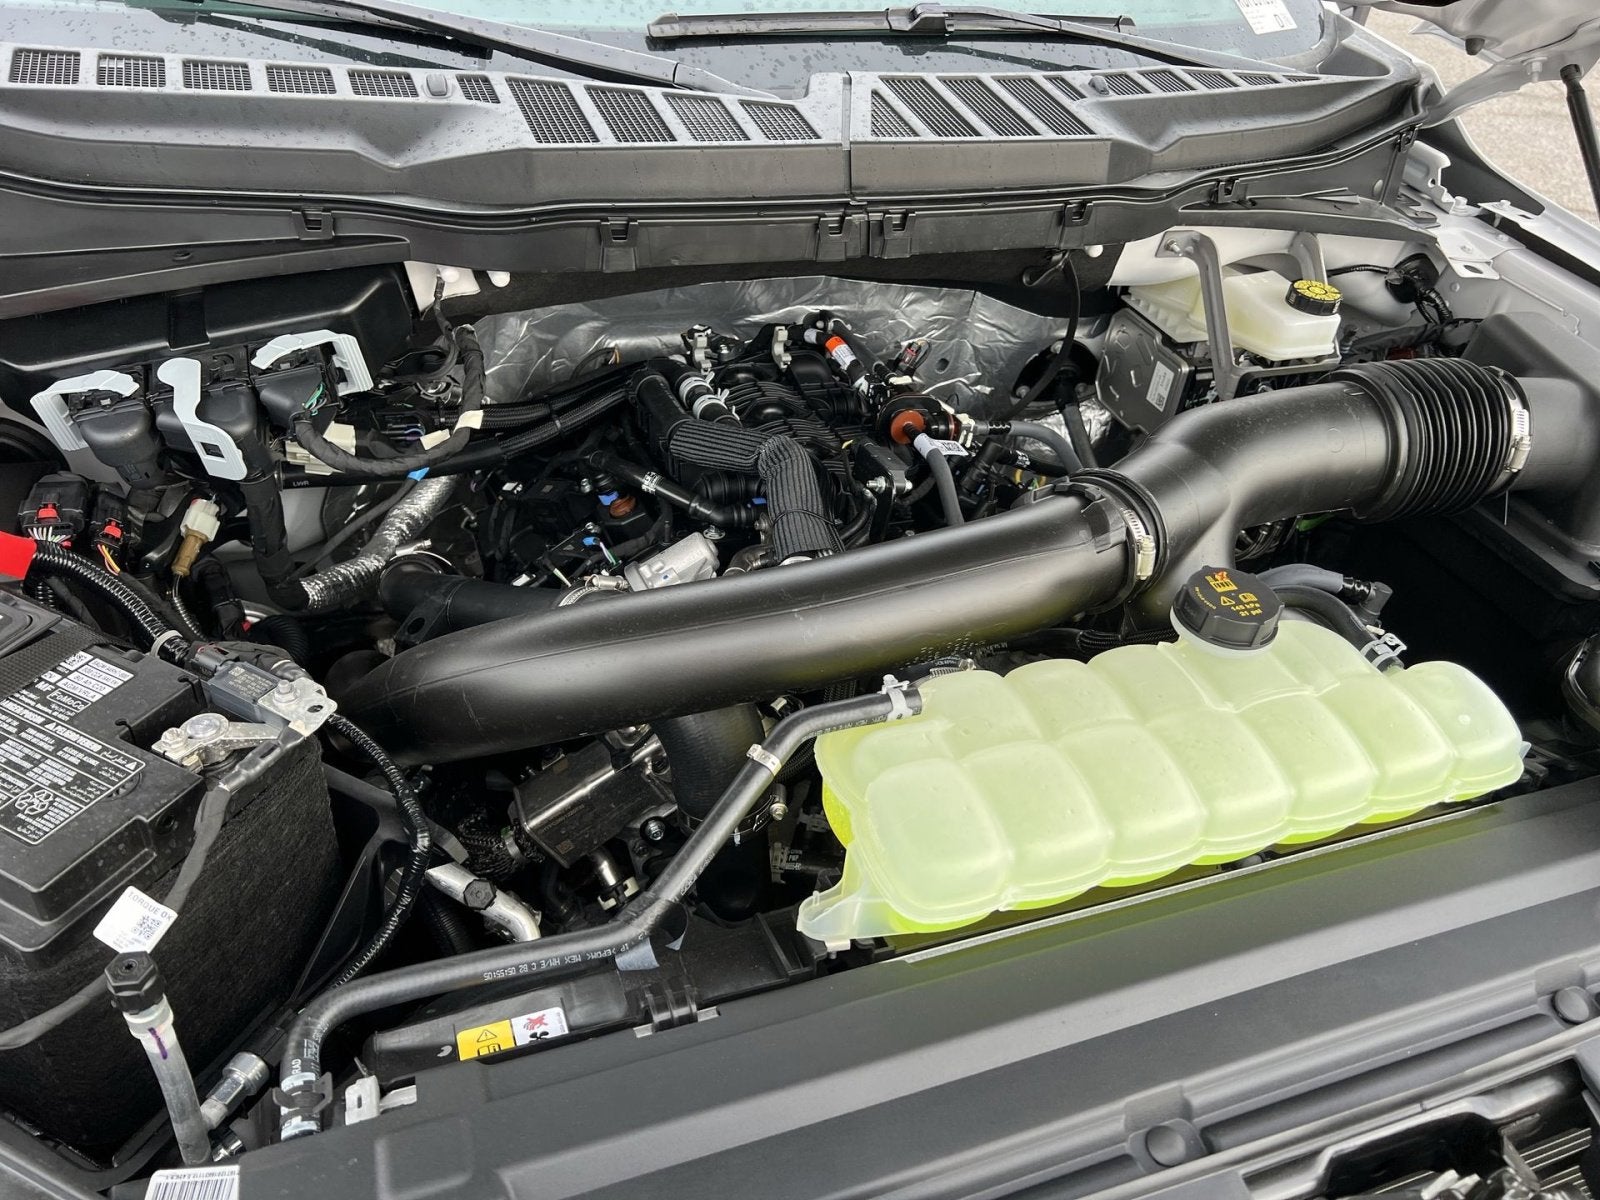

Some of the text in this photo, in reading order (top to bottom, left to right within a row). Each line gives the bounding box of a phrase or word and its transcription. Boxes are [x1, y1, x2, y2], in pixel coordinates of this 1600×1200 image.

[49, 690, 85, 710] FoMoCo
[128, 891, 174, 921] TORQUE OK
[565, 955, 582, 964] MEX
